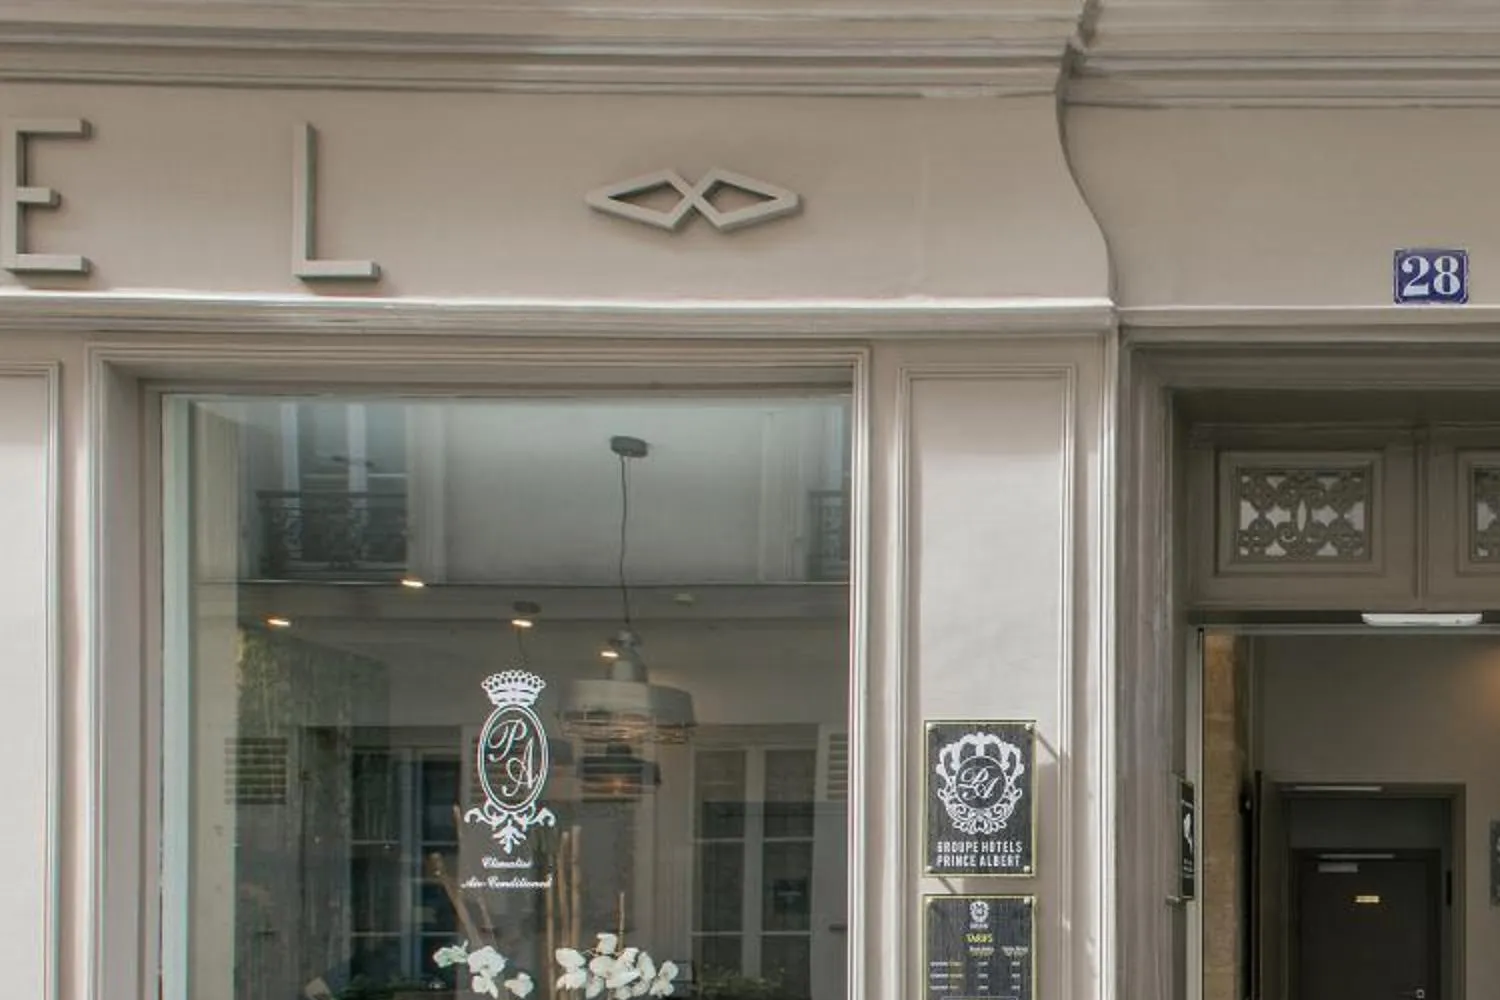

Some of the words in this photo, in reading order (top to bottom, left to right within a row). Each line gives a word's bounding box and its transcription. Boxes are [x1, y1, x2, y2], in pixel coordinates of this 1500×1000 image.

[1401, 255, 1461, 297] 28
[937, 841, 979, 853] GROUPE
[936, 854, 976, 867] PRINCE
[979, 854, 1021, 867] ALBERT
